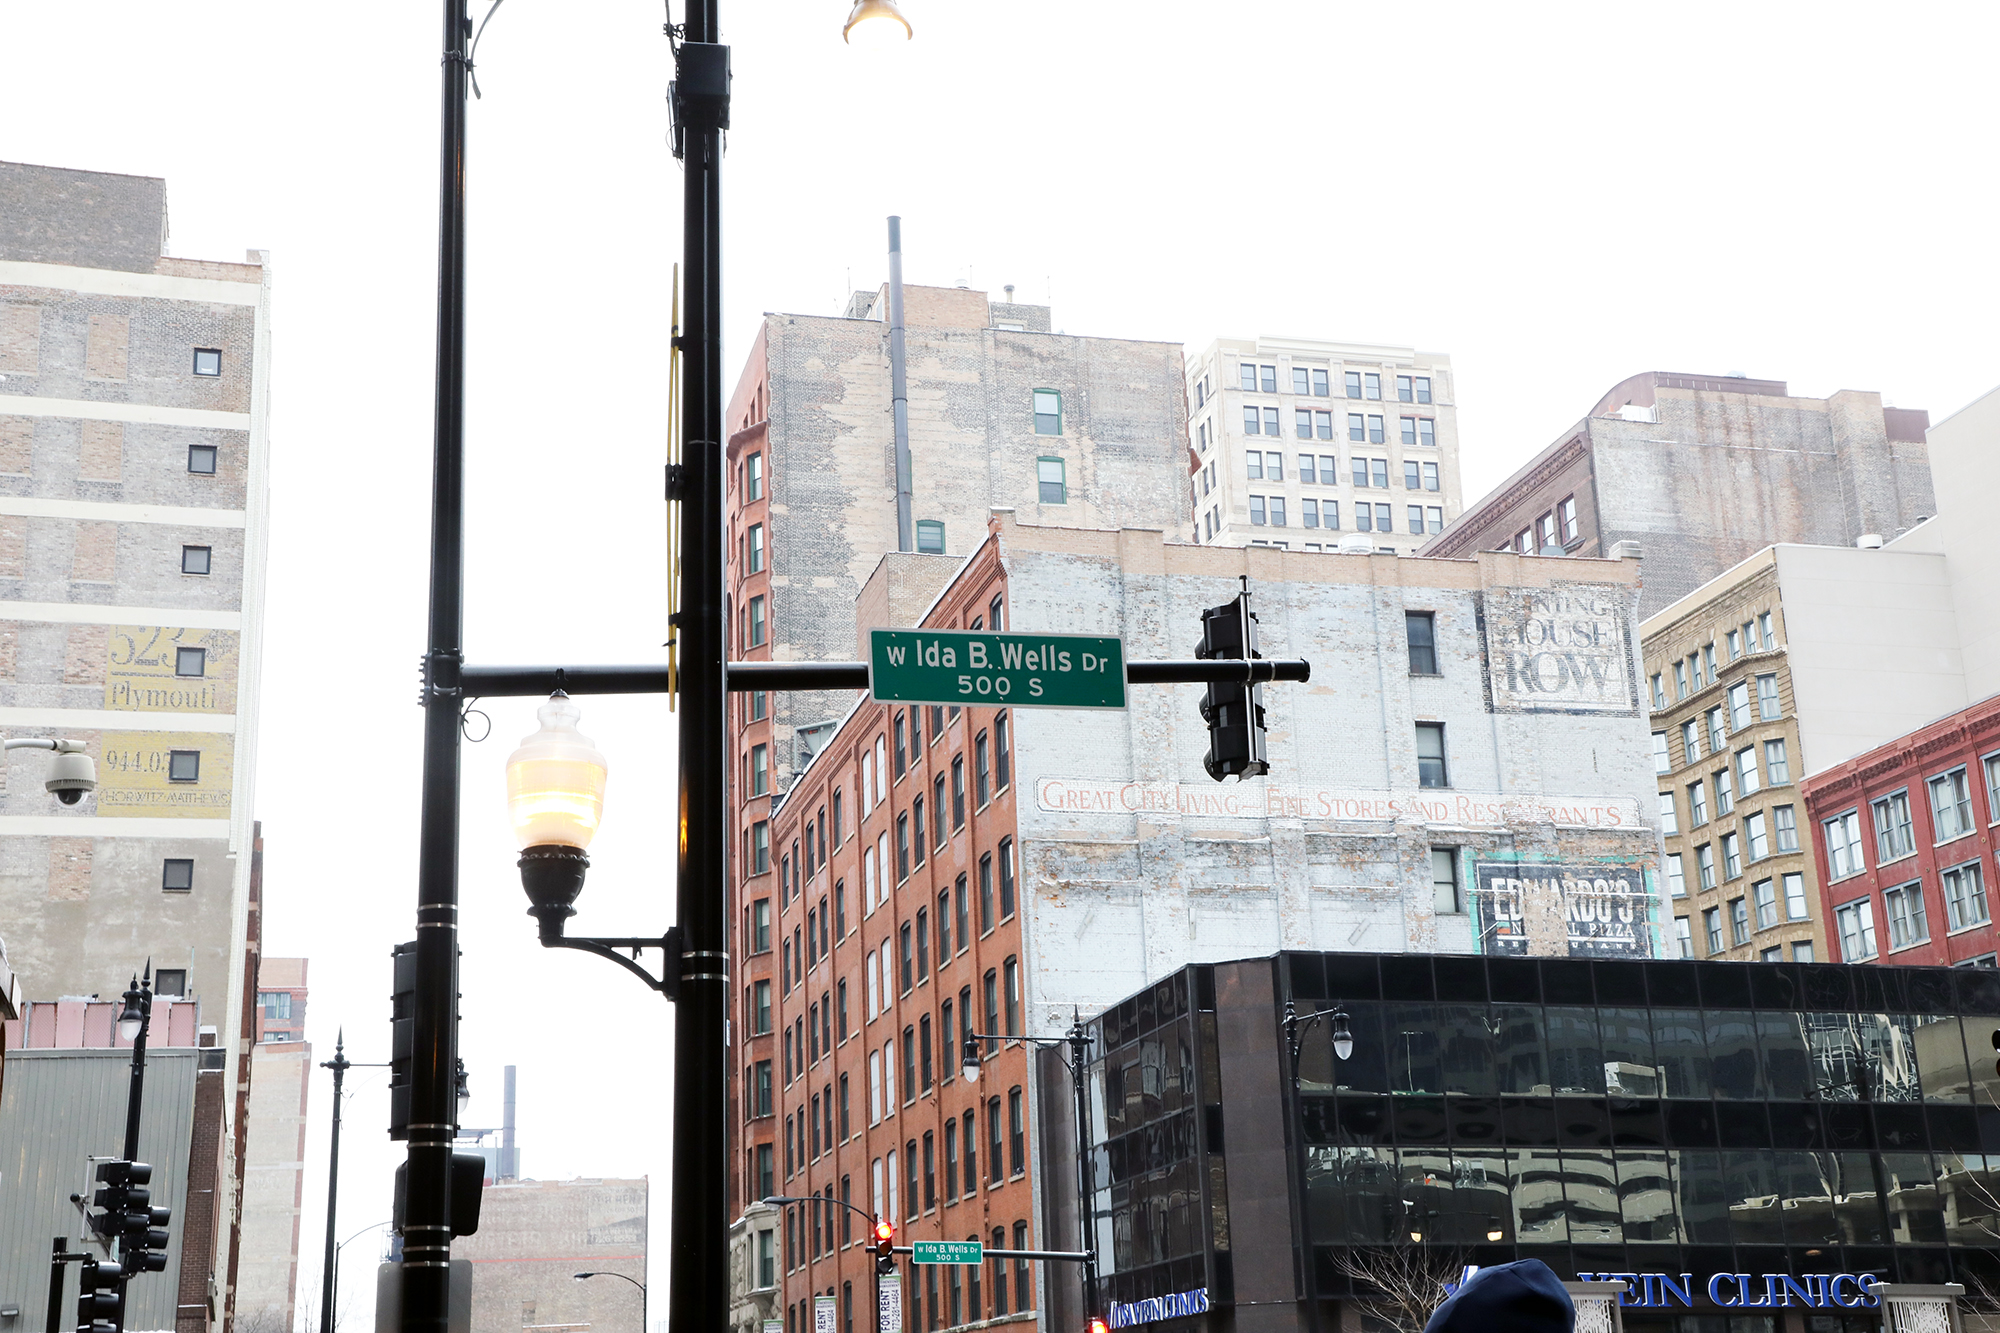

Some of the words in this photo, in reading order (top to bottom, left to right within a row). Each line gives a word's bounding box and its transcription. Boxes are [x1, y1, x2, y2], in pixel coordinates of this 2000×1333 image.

[886, 646, 906, 666] W
[916, 639, 957, 668] Ida
[968, 641, 994, 670] B.
[1000, 642, 1073, 672] Wells
[1082, 652, 1109, 673] Dr
[1505, 650, 1611, 697] ROW
[958, 675, 1011, 696] 500
[1028, 677, 1044, 697] S
[1043, 781, 1117, 810] GREAT
[1120, 783, 1170, 811] CITY
[1317, 791, 1402, 818] STORES
[1408, 797, 1448, 821] AND
[1456, 795, 1622, 826] RESRANTS
[1491, 877, 1634, 924] EDRDO'S
[1589, 923, 1635, 937] PIZZA
[1498, 940, 1637, 950] REURANT
[925, 1244, 937, 1253] Ida
[939, 1244, 947, 1253] B.
[948, 1244, 968, 1254] Wells
[969, 1246, 978, 1254] Dr
[880, 1289, 890, 1311] RENT
[1576, 1272, 1693, 1308] EIN
[1707, 1272, 1881, 1308] CLINICS
[817, 1309, 826, 1330] RENT
[880, 1314, 890, 1331] FOR
